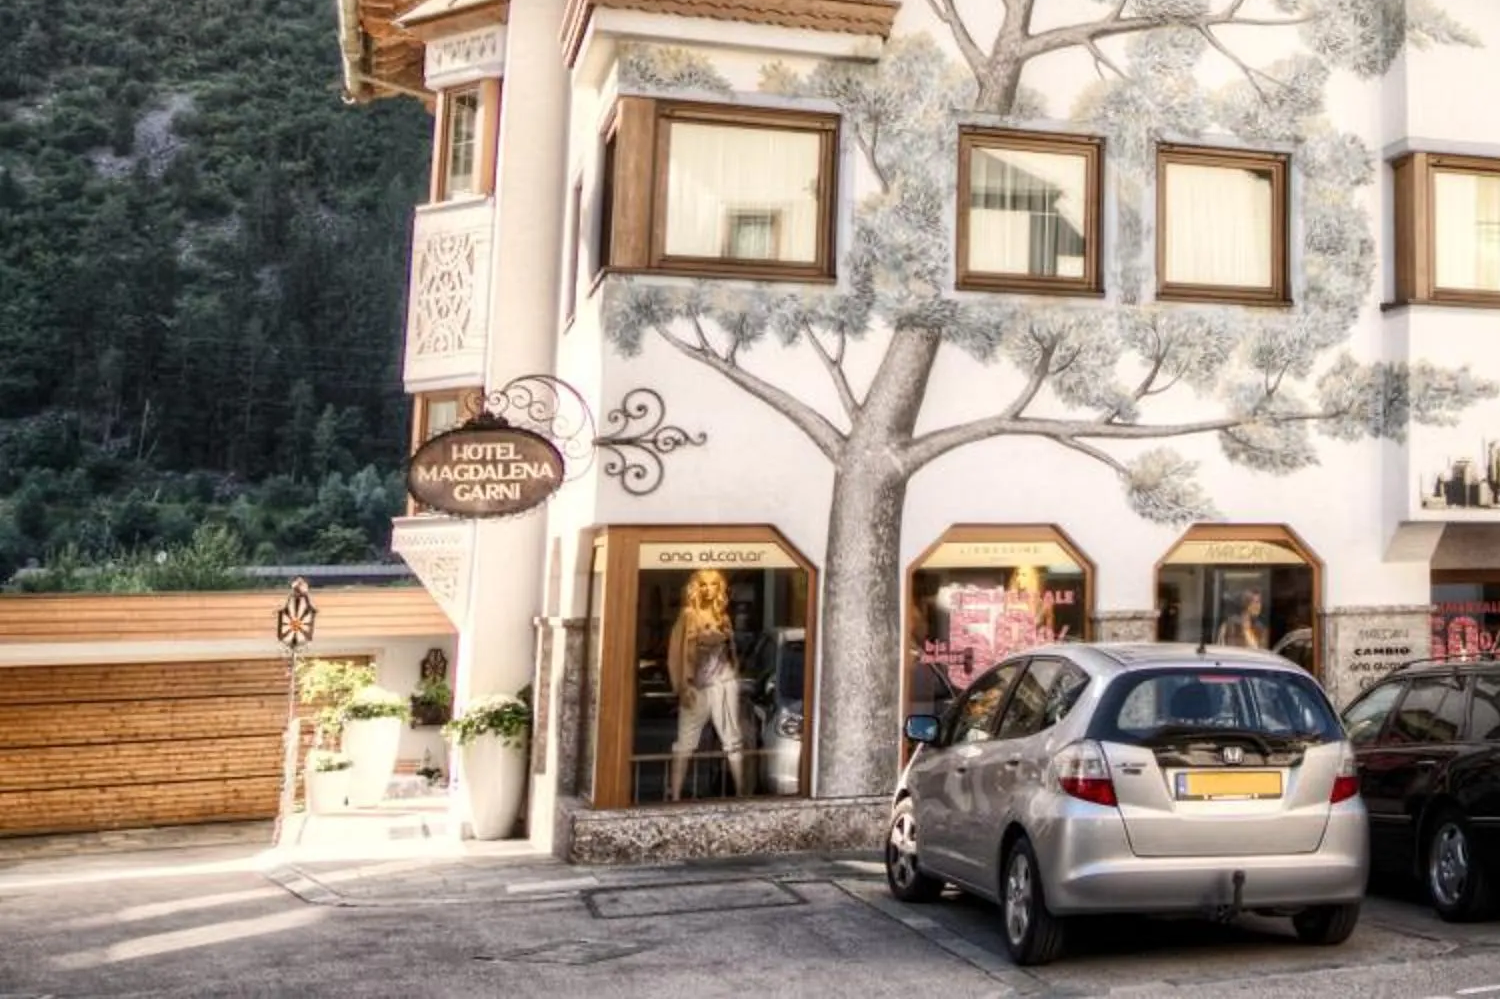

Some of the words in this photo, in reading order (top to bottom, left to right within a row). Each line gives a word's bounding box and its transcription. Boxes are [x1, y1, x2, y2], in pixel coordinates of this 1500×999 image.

[451, 443, 522, 461] HOTEL
[417, 462, 554, 482] MAGDALENA
[453, 483, 521, 501] GARNI
[659, 550, 693, 562] ana
